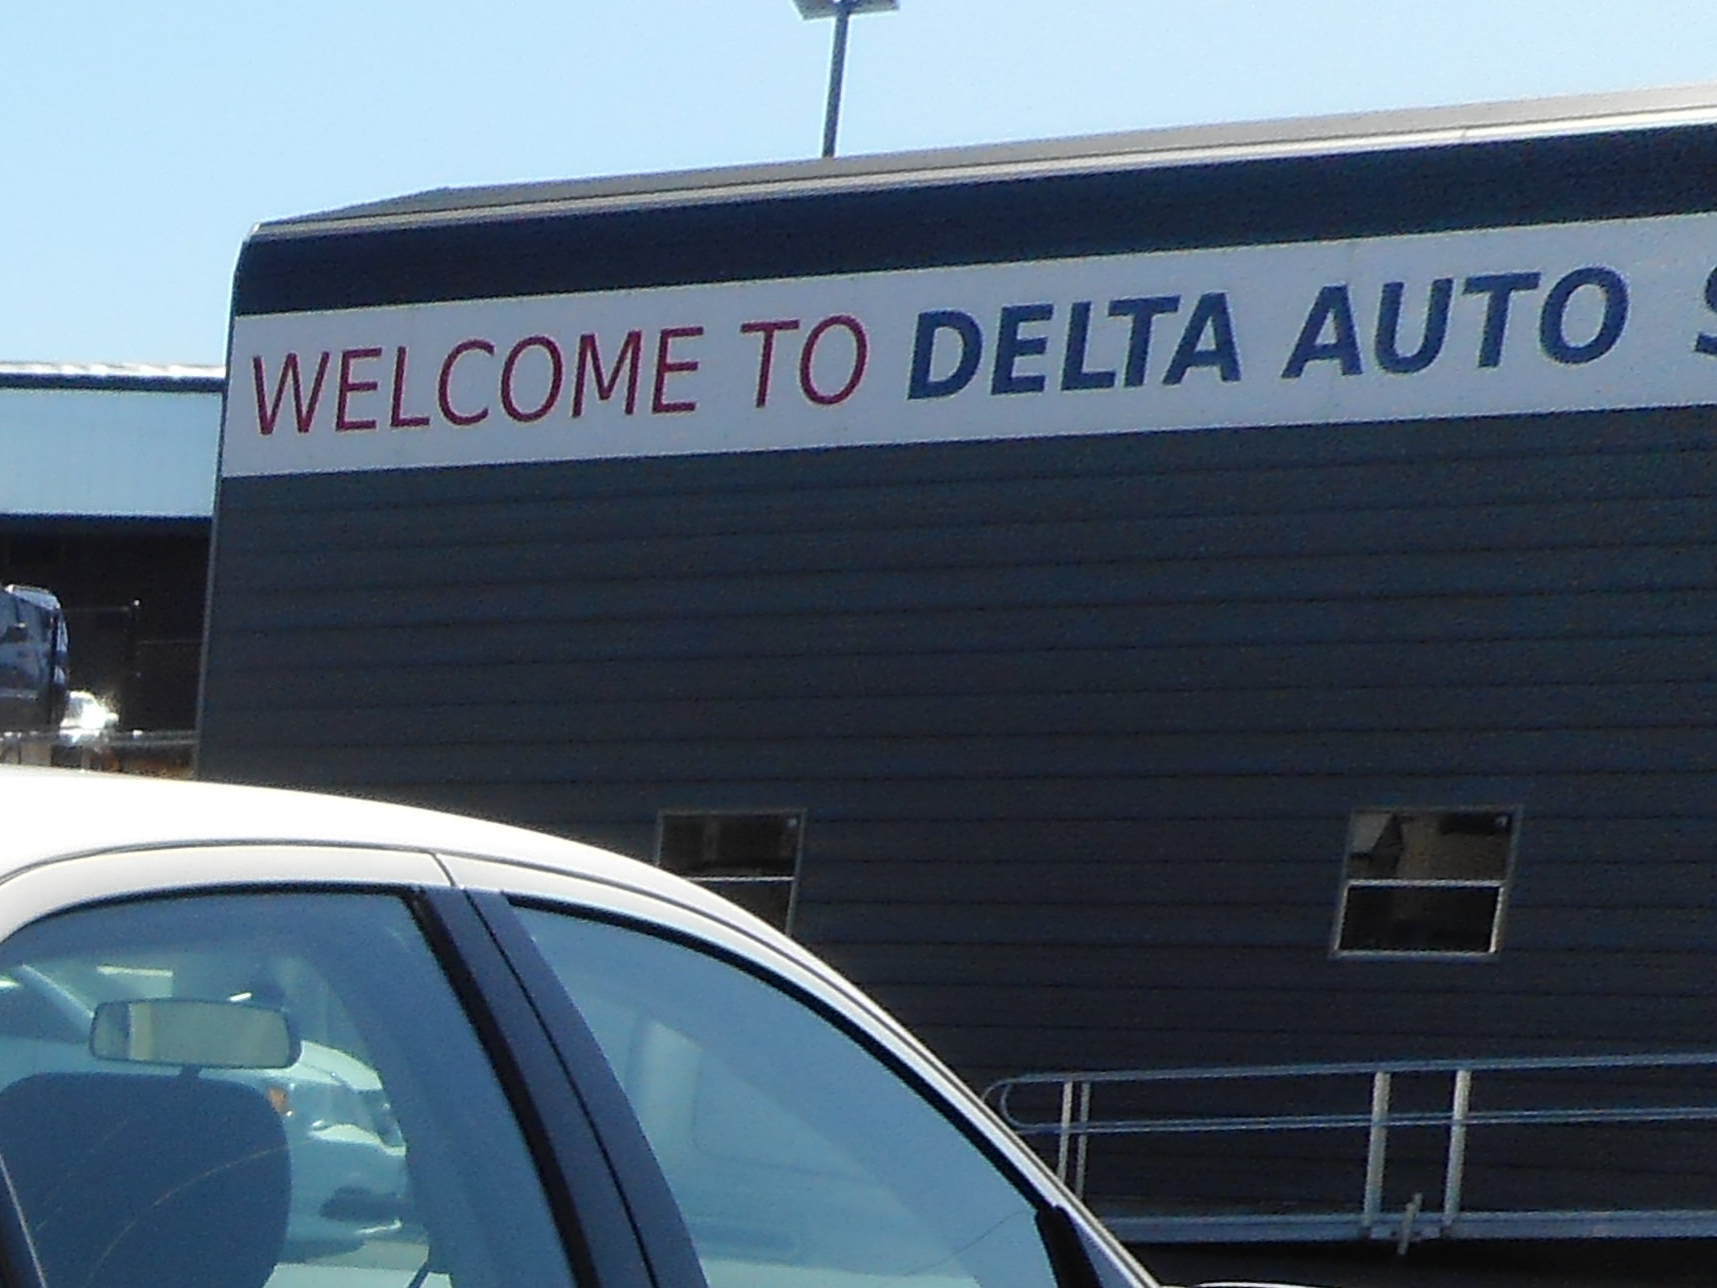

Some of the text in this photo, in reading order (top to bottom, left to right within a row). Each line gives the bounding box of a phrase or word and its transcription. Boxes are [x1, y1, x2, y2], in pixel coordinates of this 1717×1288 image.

[251, 325, 705, 436] WELCOME
[739, 313, 868, 410] TO
[906, 291, 1243, 401] DELTA
[1281, 264, 1630, 380] AUTO
